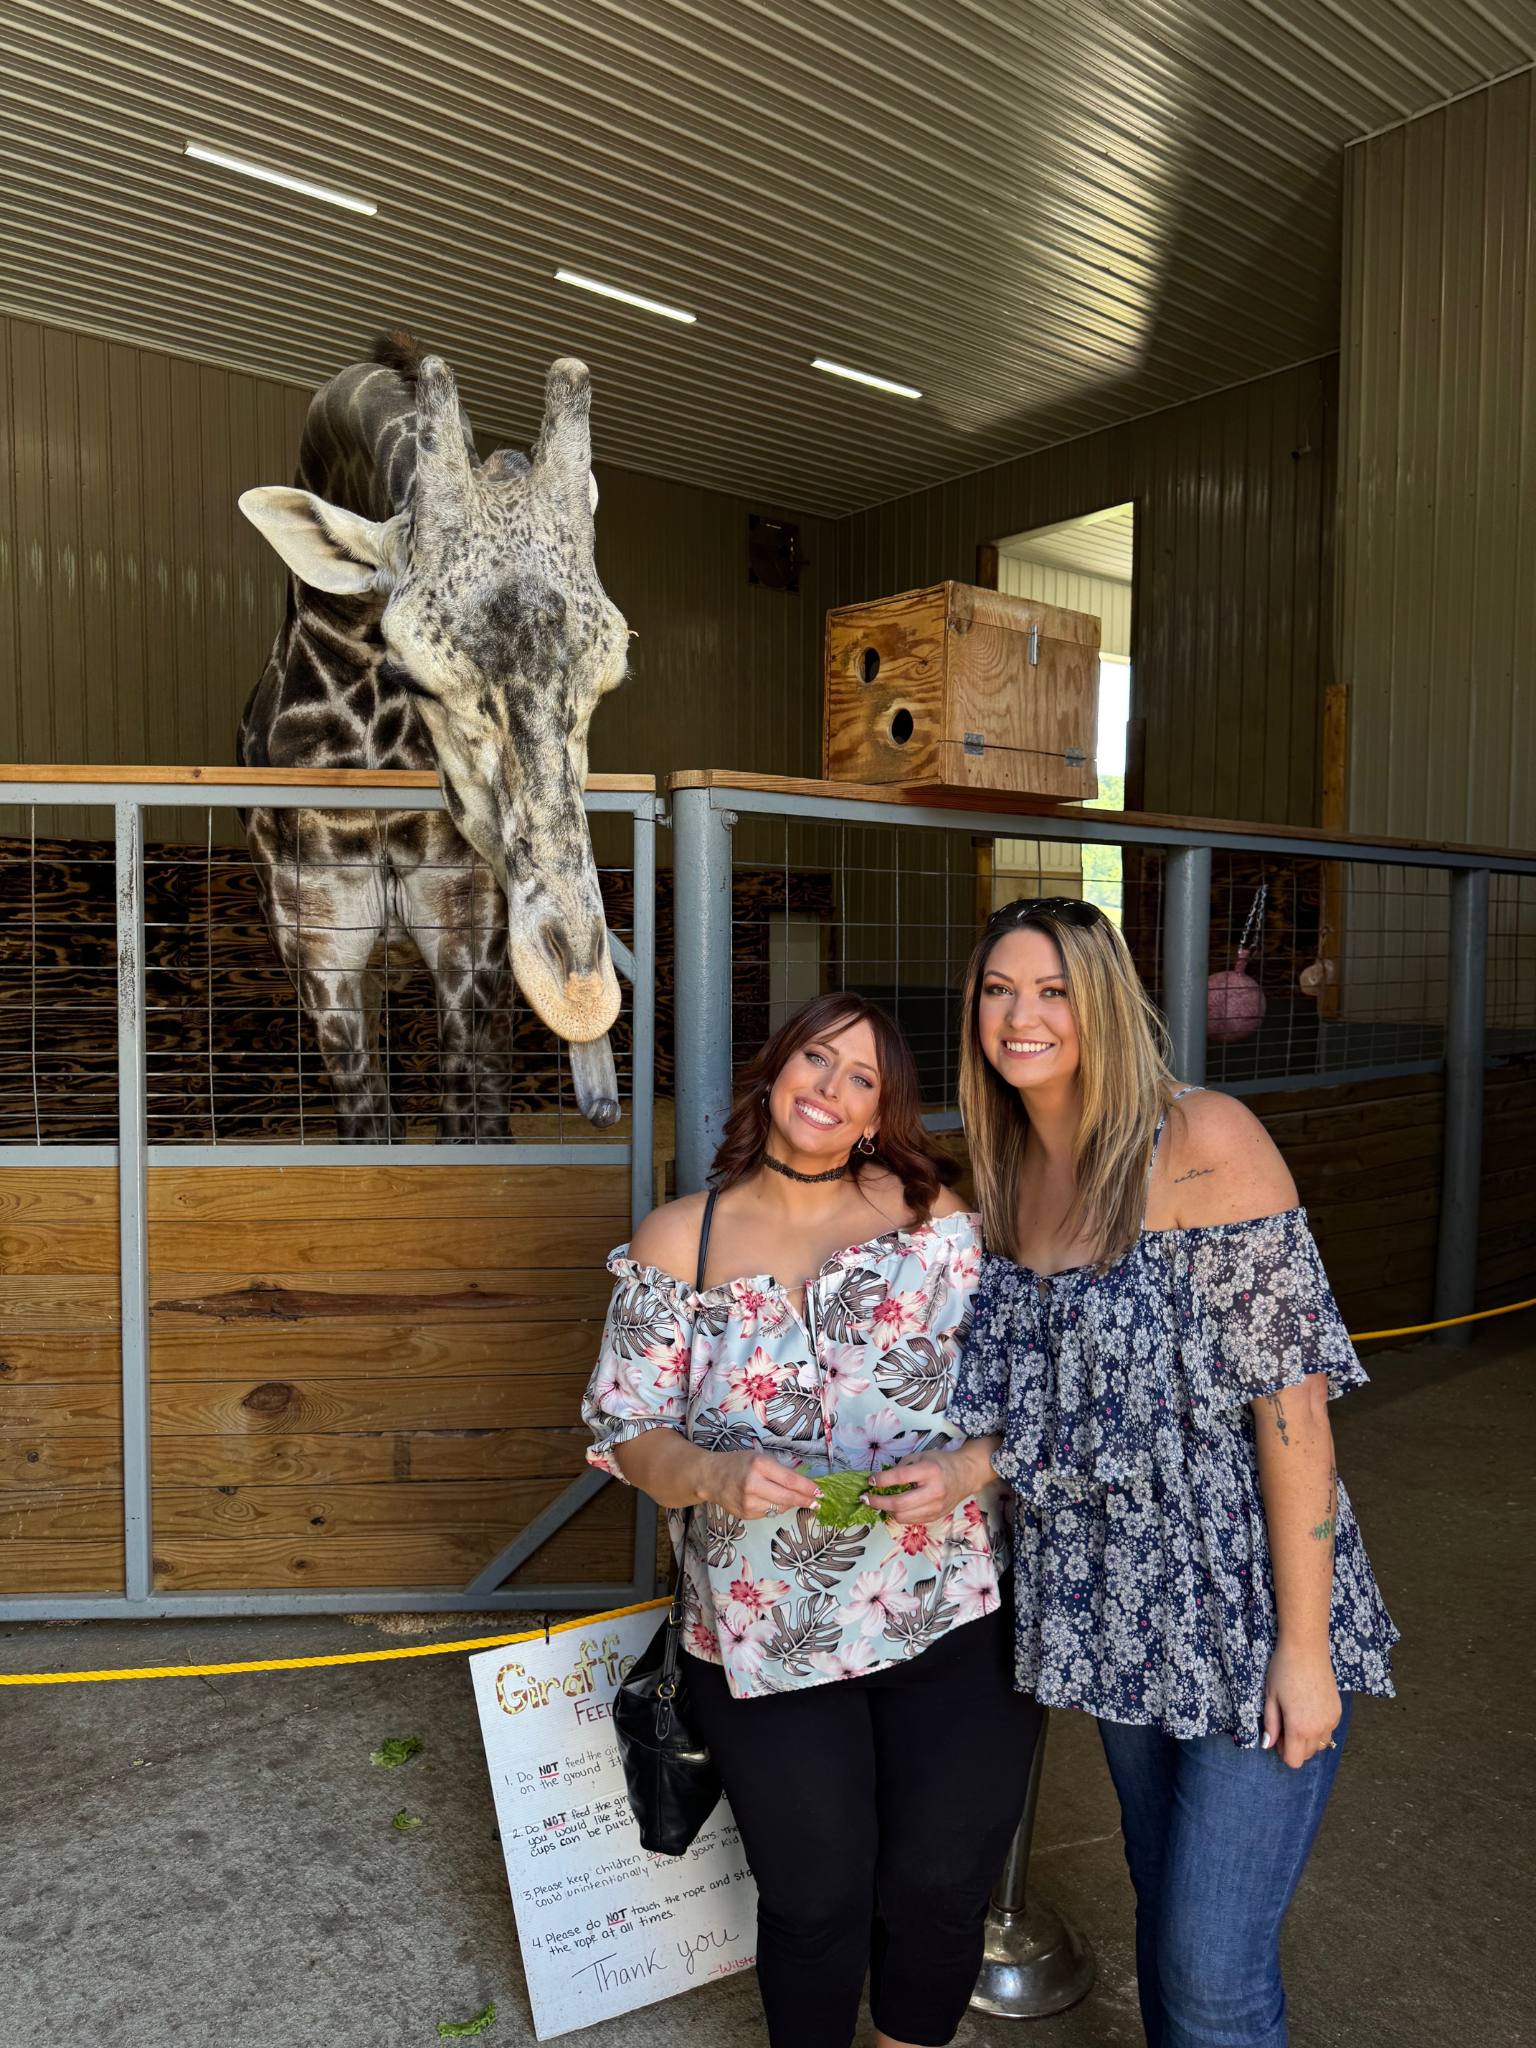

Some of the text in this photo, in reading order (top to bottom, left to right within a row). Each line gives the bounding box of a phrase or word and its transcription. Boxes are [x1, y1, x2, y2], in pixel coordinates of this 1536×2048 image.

[496, 1632, 637, 1715] Giraffe
[574, 1698, 615, 1725] FEED
[517, 1771, 533, 1783] Do
[539, 1761, 559, 1776] NOT
[565, 1753, 586, 1768] feed
[587, 1750, 602, 1761] the
[605, 1745, 619, 1757] gir
[520, 1784, 536, 1795] on
[540, 1777, 559, 1790] the
[564, 1761, 601, 1785] ground
[512, 1795, 629, 1839] 2. Do NOT feed the gir
[528, 1808, 626, 1849] you would like to
[530, 1815, 640, 1858] cups can be purch
[523, 1890, 534, 1901] 3.
[533, 1881, 562, 1897] Please
[596, 1855, 641, 1875] children
[536, 1892, 562, 1908] could
[567, 1867, 649, 1897] unintentionally
[691, 1842, 716, 1861] your
[545, 1926, 581, 1944] Please
[586, 1919, 601, 1931] do
[605, 1908, 628, 1924] NOT
[632, 1901, 661, 1915] touch
[664, 1894, 681, 1905] the
[683, 1885, 707, 1899] rope
[710, 1873, 730, 1889] and
[734, 1868, 753, 1881] sta
[549, 1943, 571, 1956] the
[574, 1934, 598, 1949] rope
[601, 1927, 616, 1939] at
[620, 1922, 634, 1934] all
[676, 1928, 740, 1975] you
